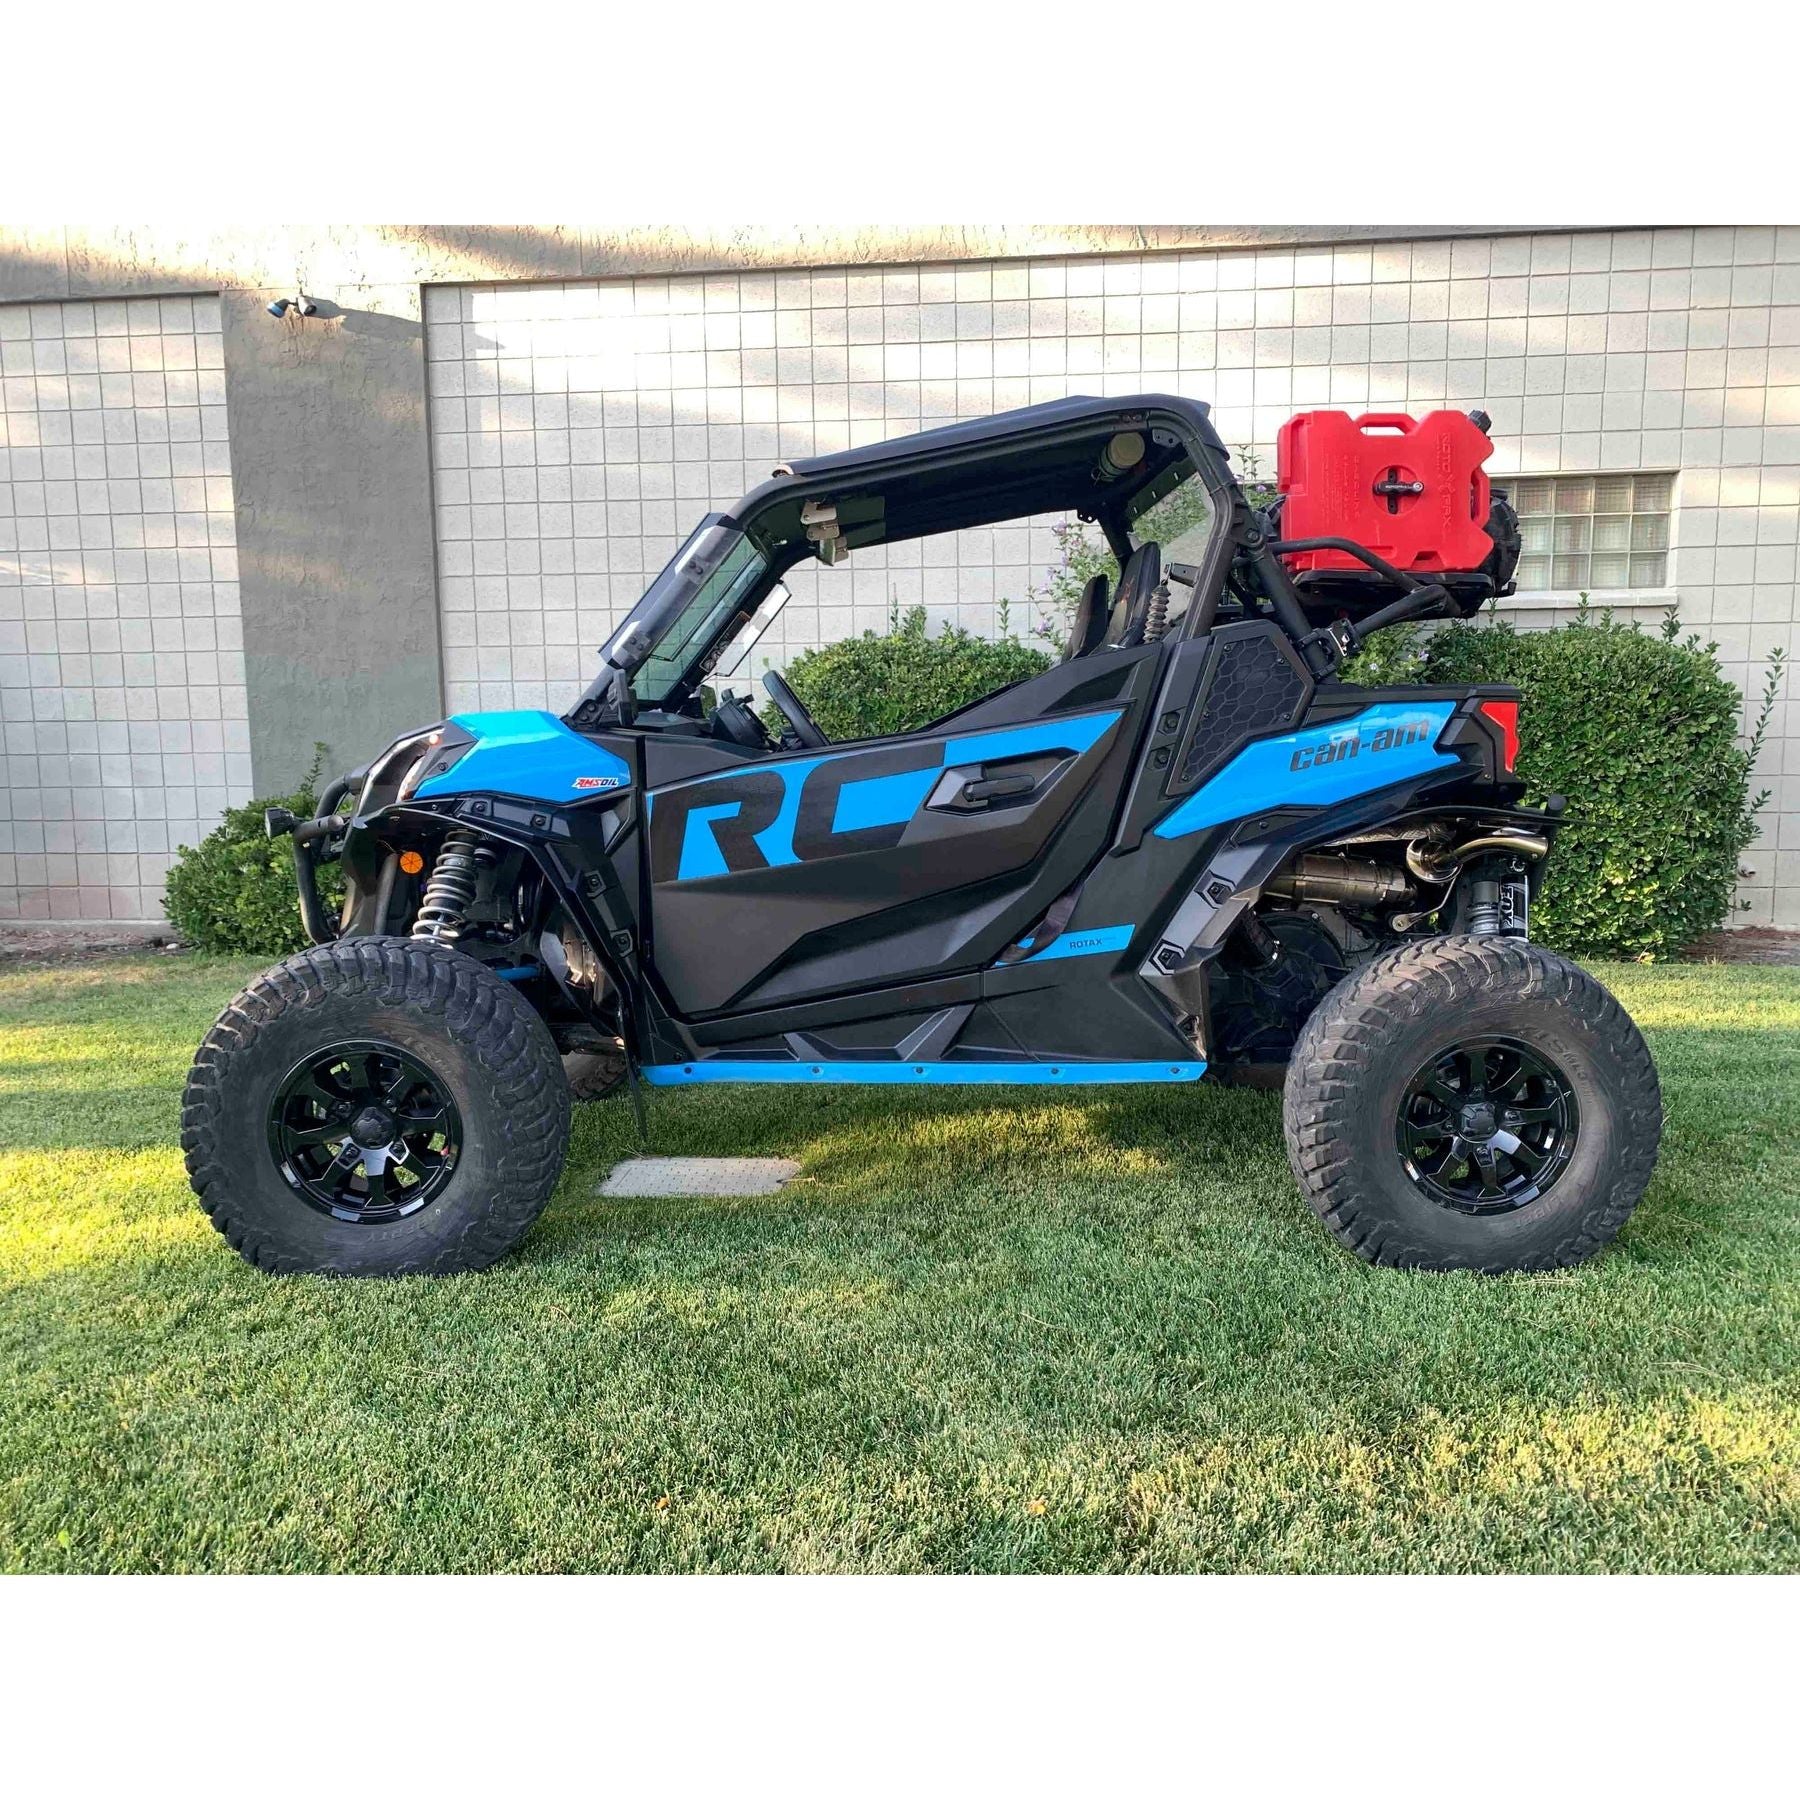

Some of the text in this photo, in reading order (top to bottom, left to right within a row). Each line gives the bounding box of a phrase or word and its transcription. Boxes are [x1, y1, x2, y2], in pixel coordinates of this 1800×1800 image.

[1290, 720, 1430, 772] can-am
[575, 778, 618, 787] AMSOIL
[650, 742, 946, 883] RC
[1500, 885, 1514, 928] FOX
[1069, 938, 1103, 949] ROTAX
